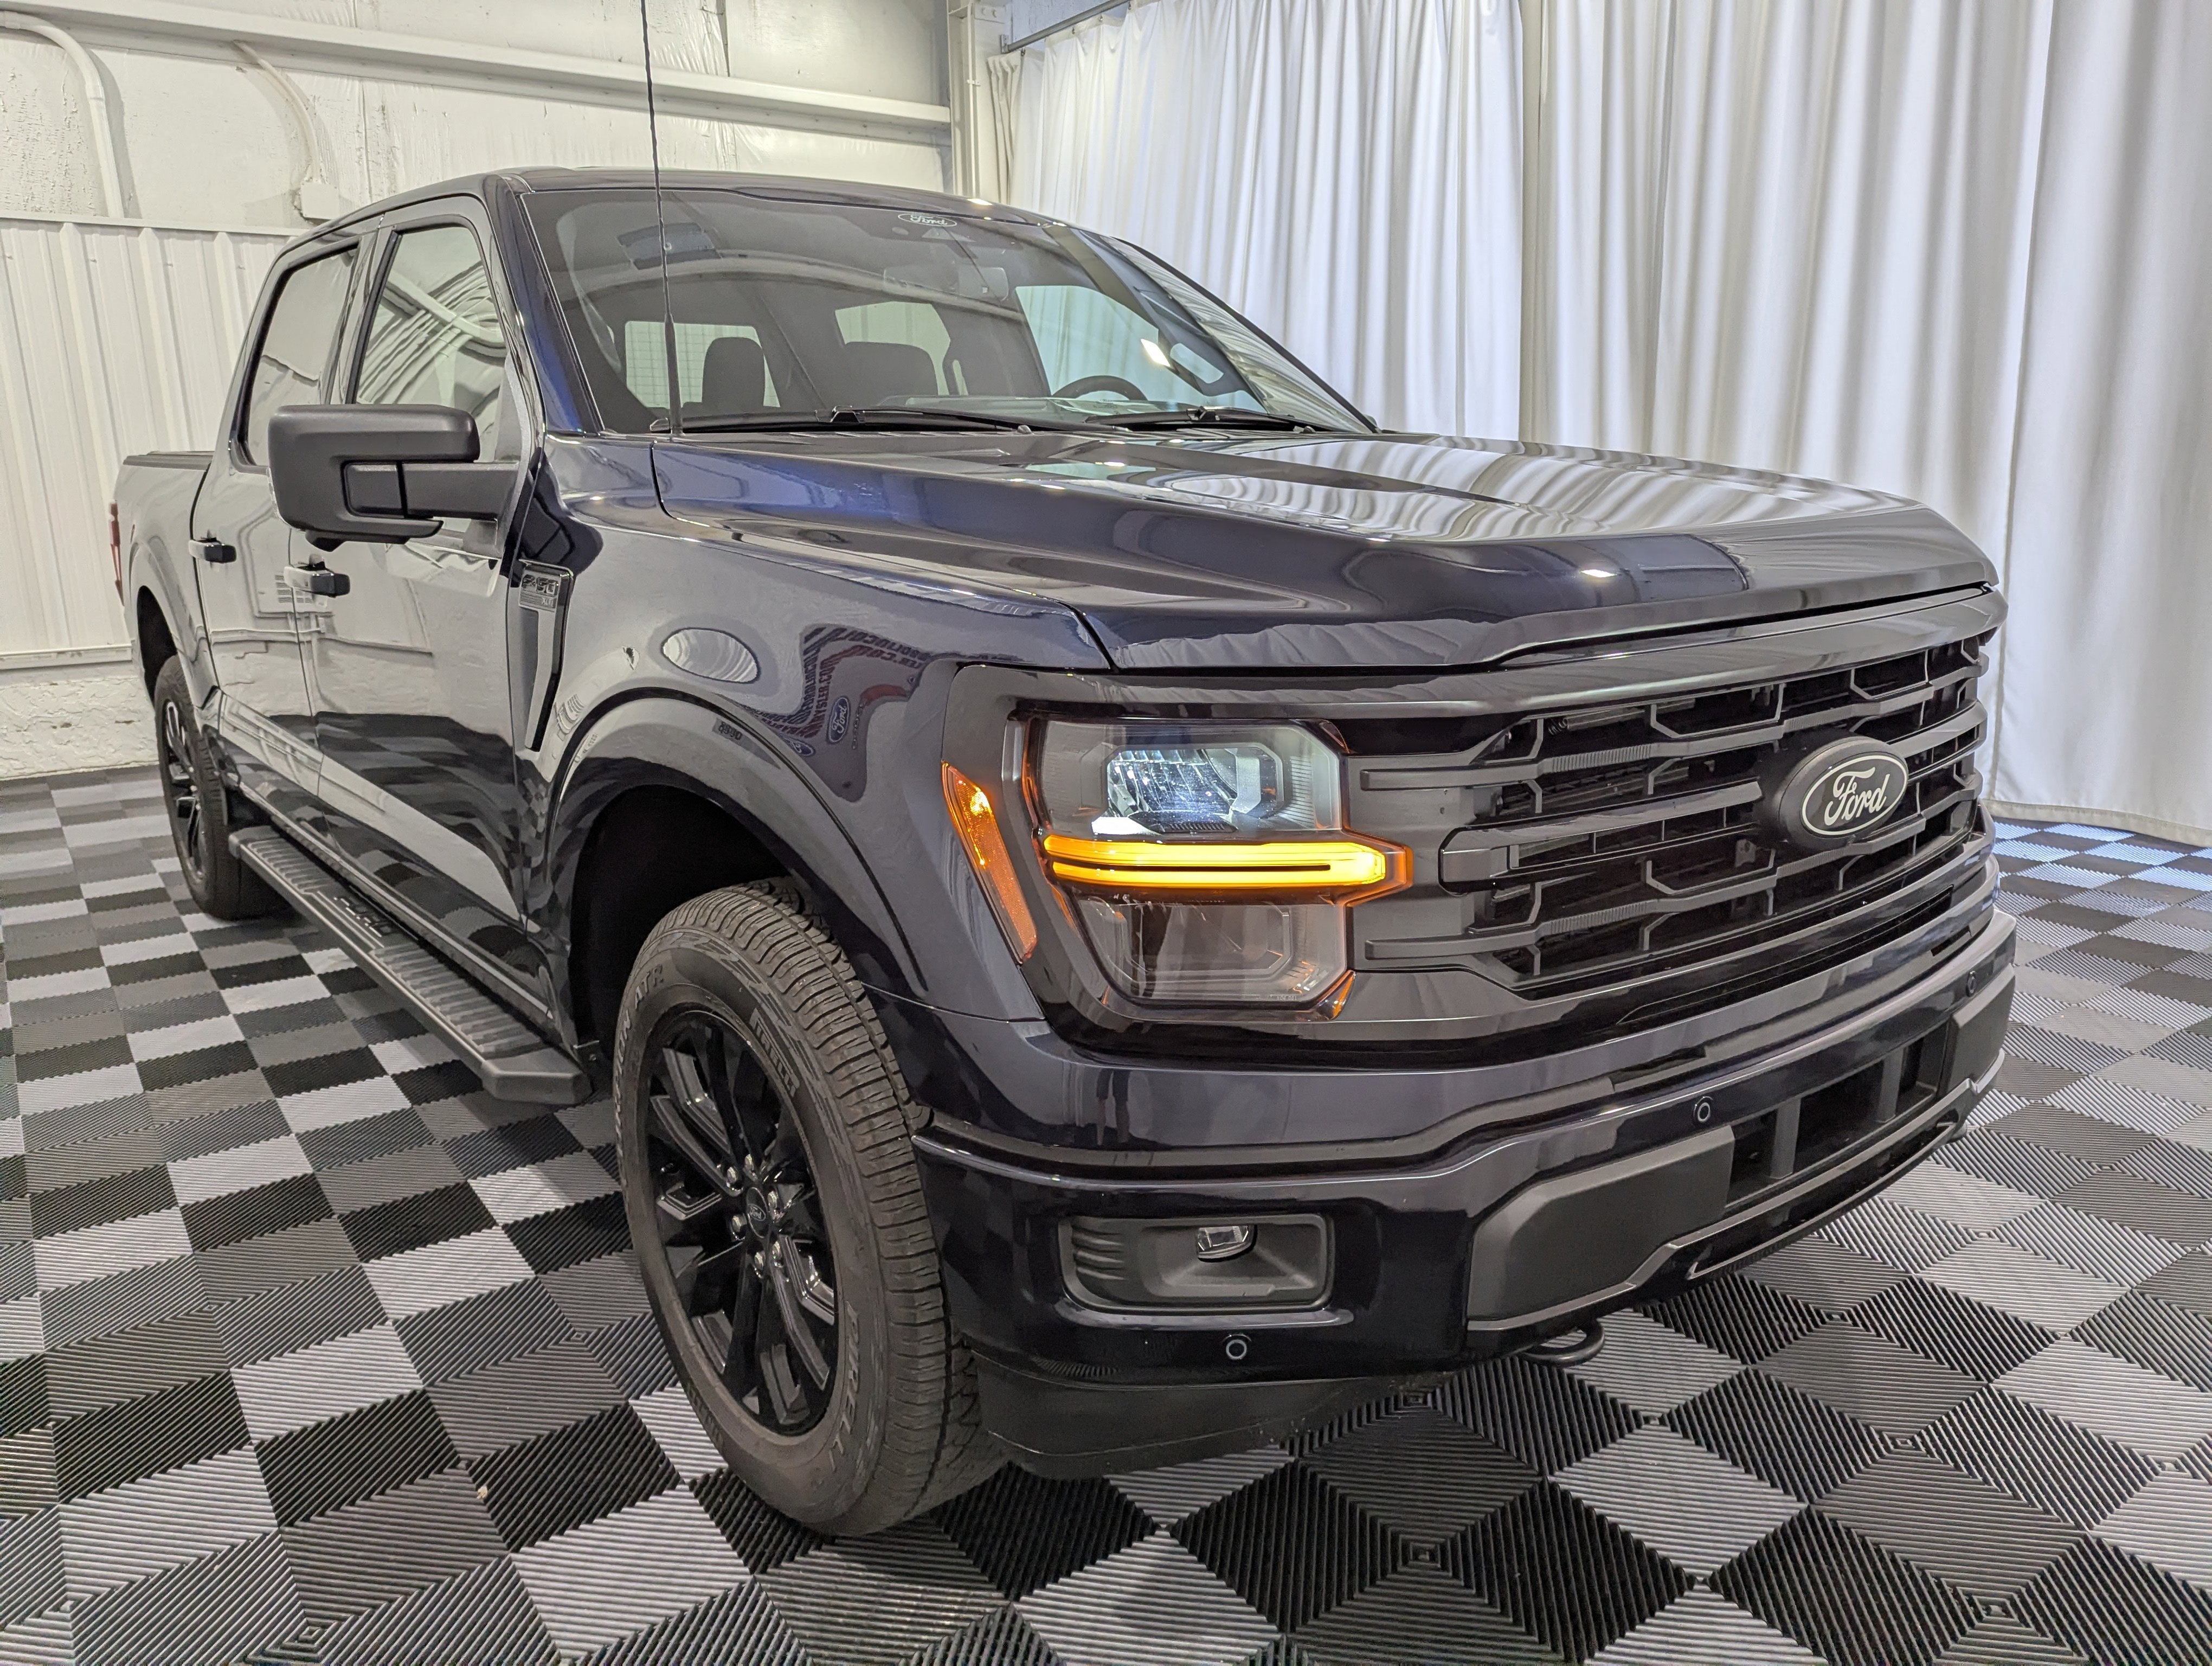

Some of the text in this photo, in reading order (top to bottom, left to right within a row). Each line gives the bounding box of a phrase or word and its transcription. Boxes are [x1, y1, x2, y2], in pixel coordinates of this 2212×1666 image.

[910, 214, 948, 226] Ford
[832, 703, 847, 733] Ford
[1824, 767, 1890, 826] Ford
[634, 964, 665, 1010] ATR
[750, 1205, 762, 1219] Ford
